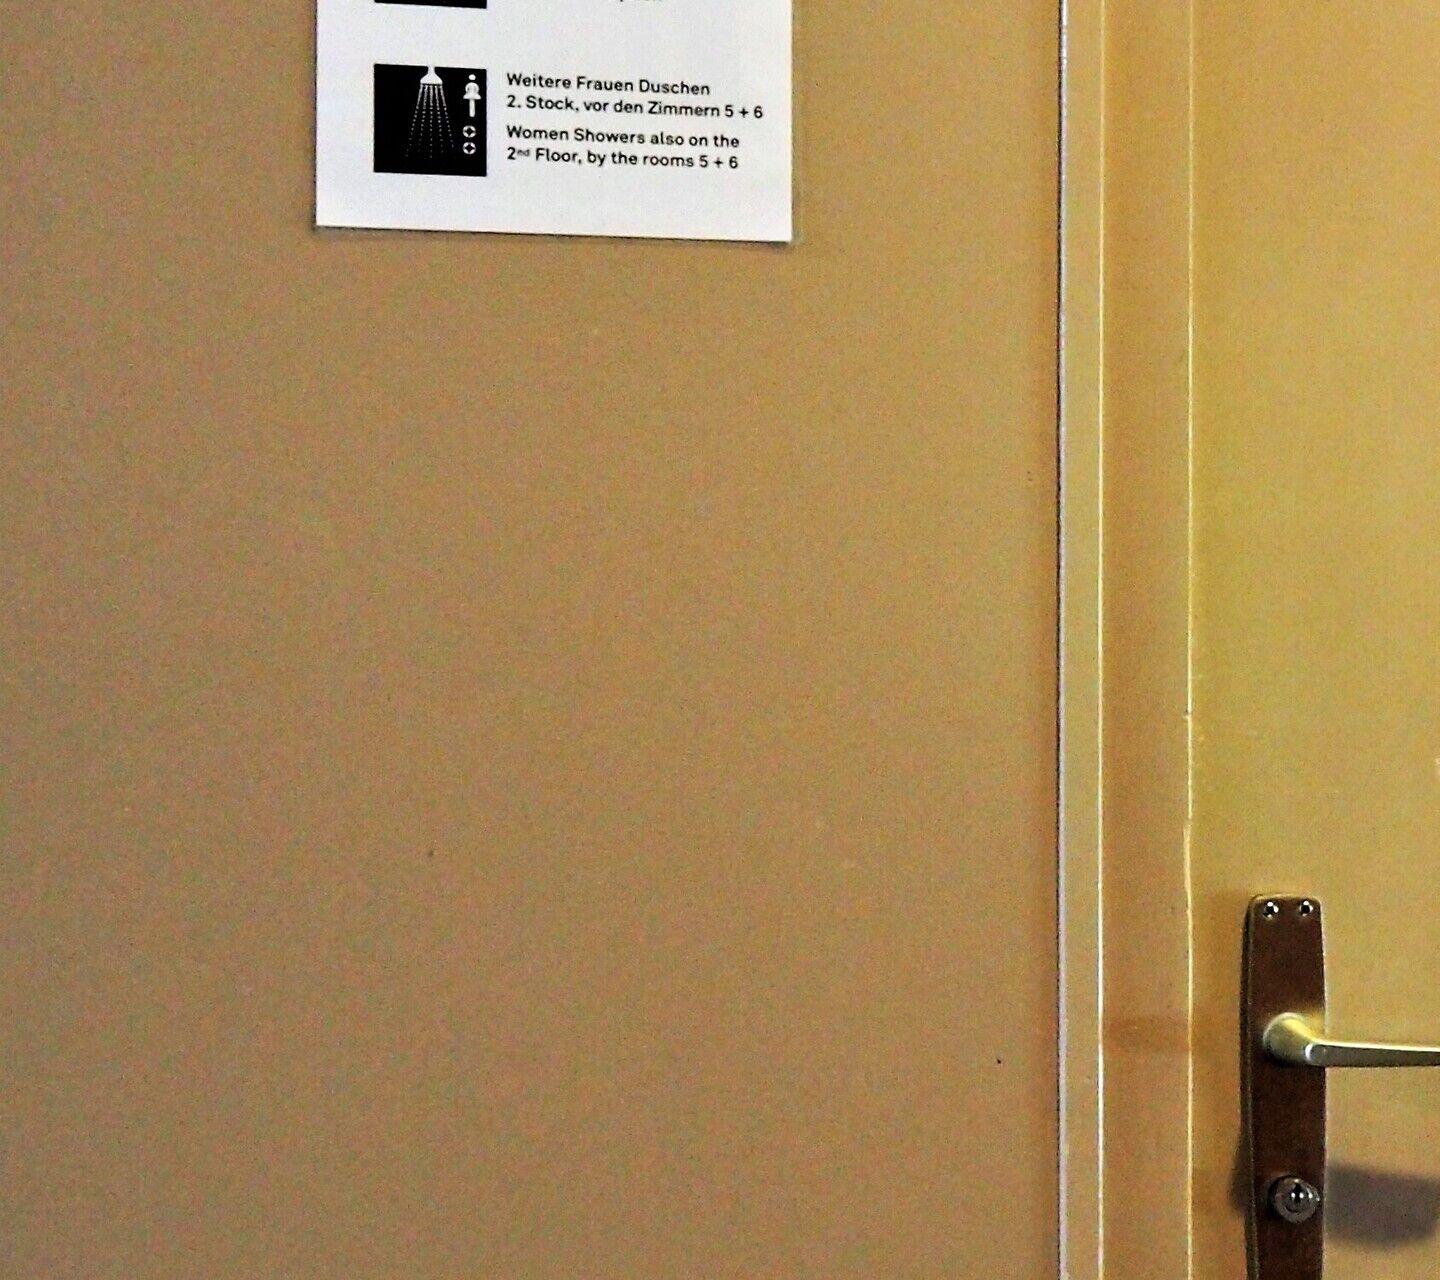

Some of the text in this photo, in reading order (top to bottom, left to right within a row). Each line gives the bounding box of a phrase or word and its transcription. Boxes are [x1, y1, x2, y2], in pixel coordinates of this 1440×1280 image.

[507, 73, 711, 95] Weitere Frauen Duschen
[507, 94, 763, 118] 2. Stock, vor den Zimmern 5 + 6
[507, 125, 740, 148] Women Showers also on the
[535, 148, 582, 166] Floor,
[587, 151, 606, 167] by
[611, 152, 638, 165] the
[643, 155, 694, 167] rooms
[699, 155, 708, 168] 5
[713, 157, 724, 167] +
[729, 156, 739, 169] 6
